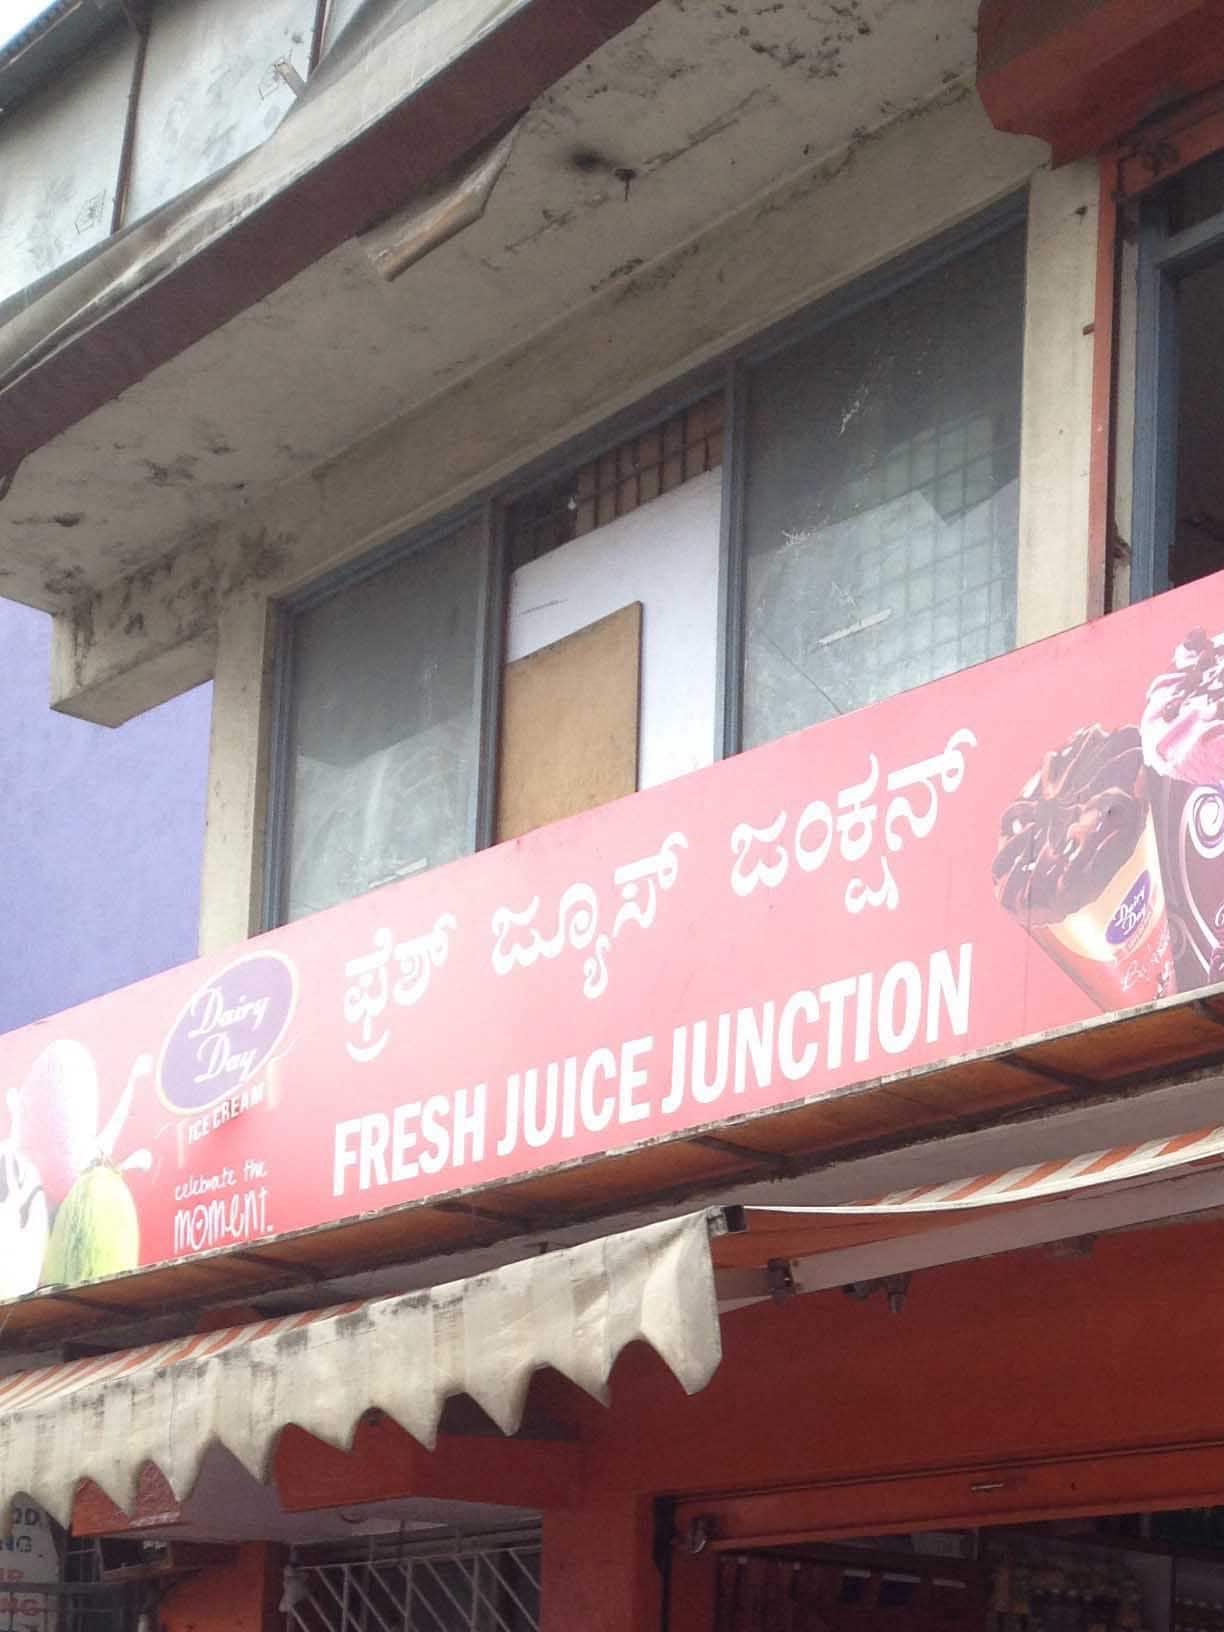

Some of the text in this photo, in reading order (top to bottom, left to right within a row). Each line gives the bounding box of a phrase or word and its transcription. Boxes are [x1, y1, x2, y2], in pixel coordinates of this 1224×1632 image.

[188, 986, 271, 1039] Dairy
[193, 1031, 258, 1083] Day
[333, 943, 973, 1196] FRESH JUICE JUNCTION
[188, 1083, 266, 1144] ICE CREAM
[175, 1159, 268, 1200] celebrate the
